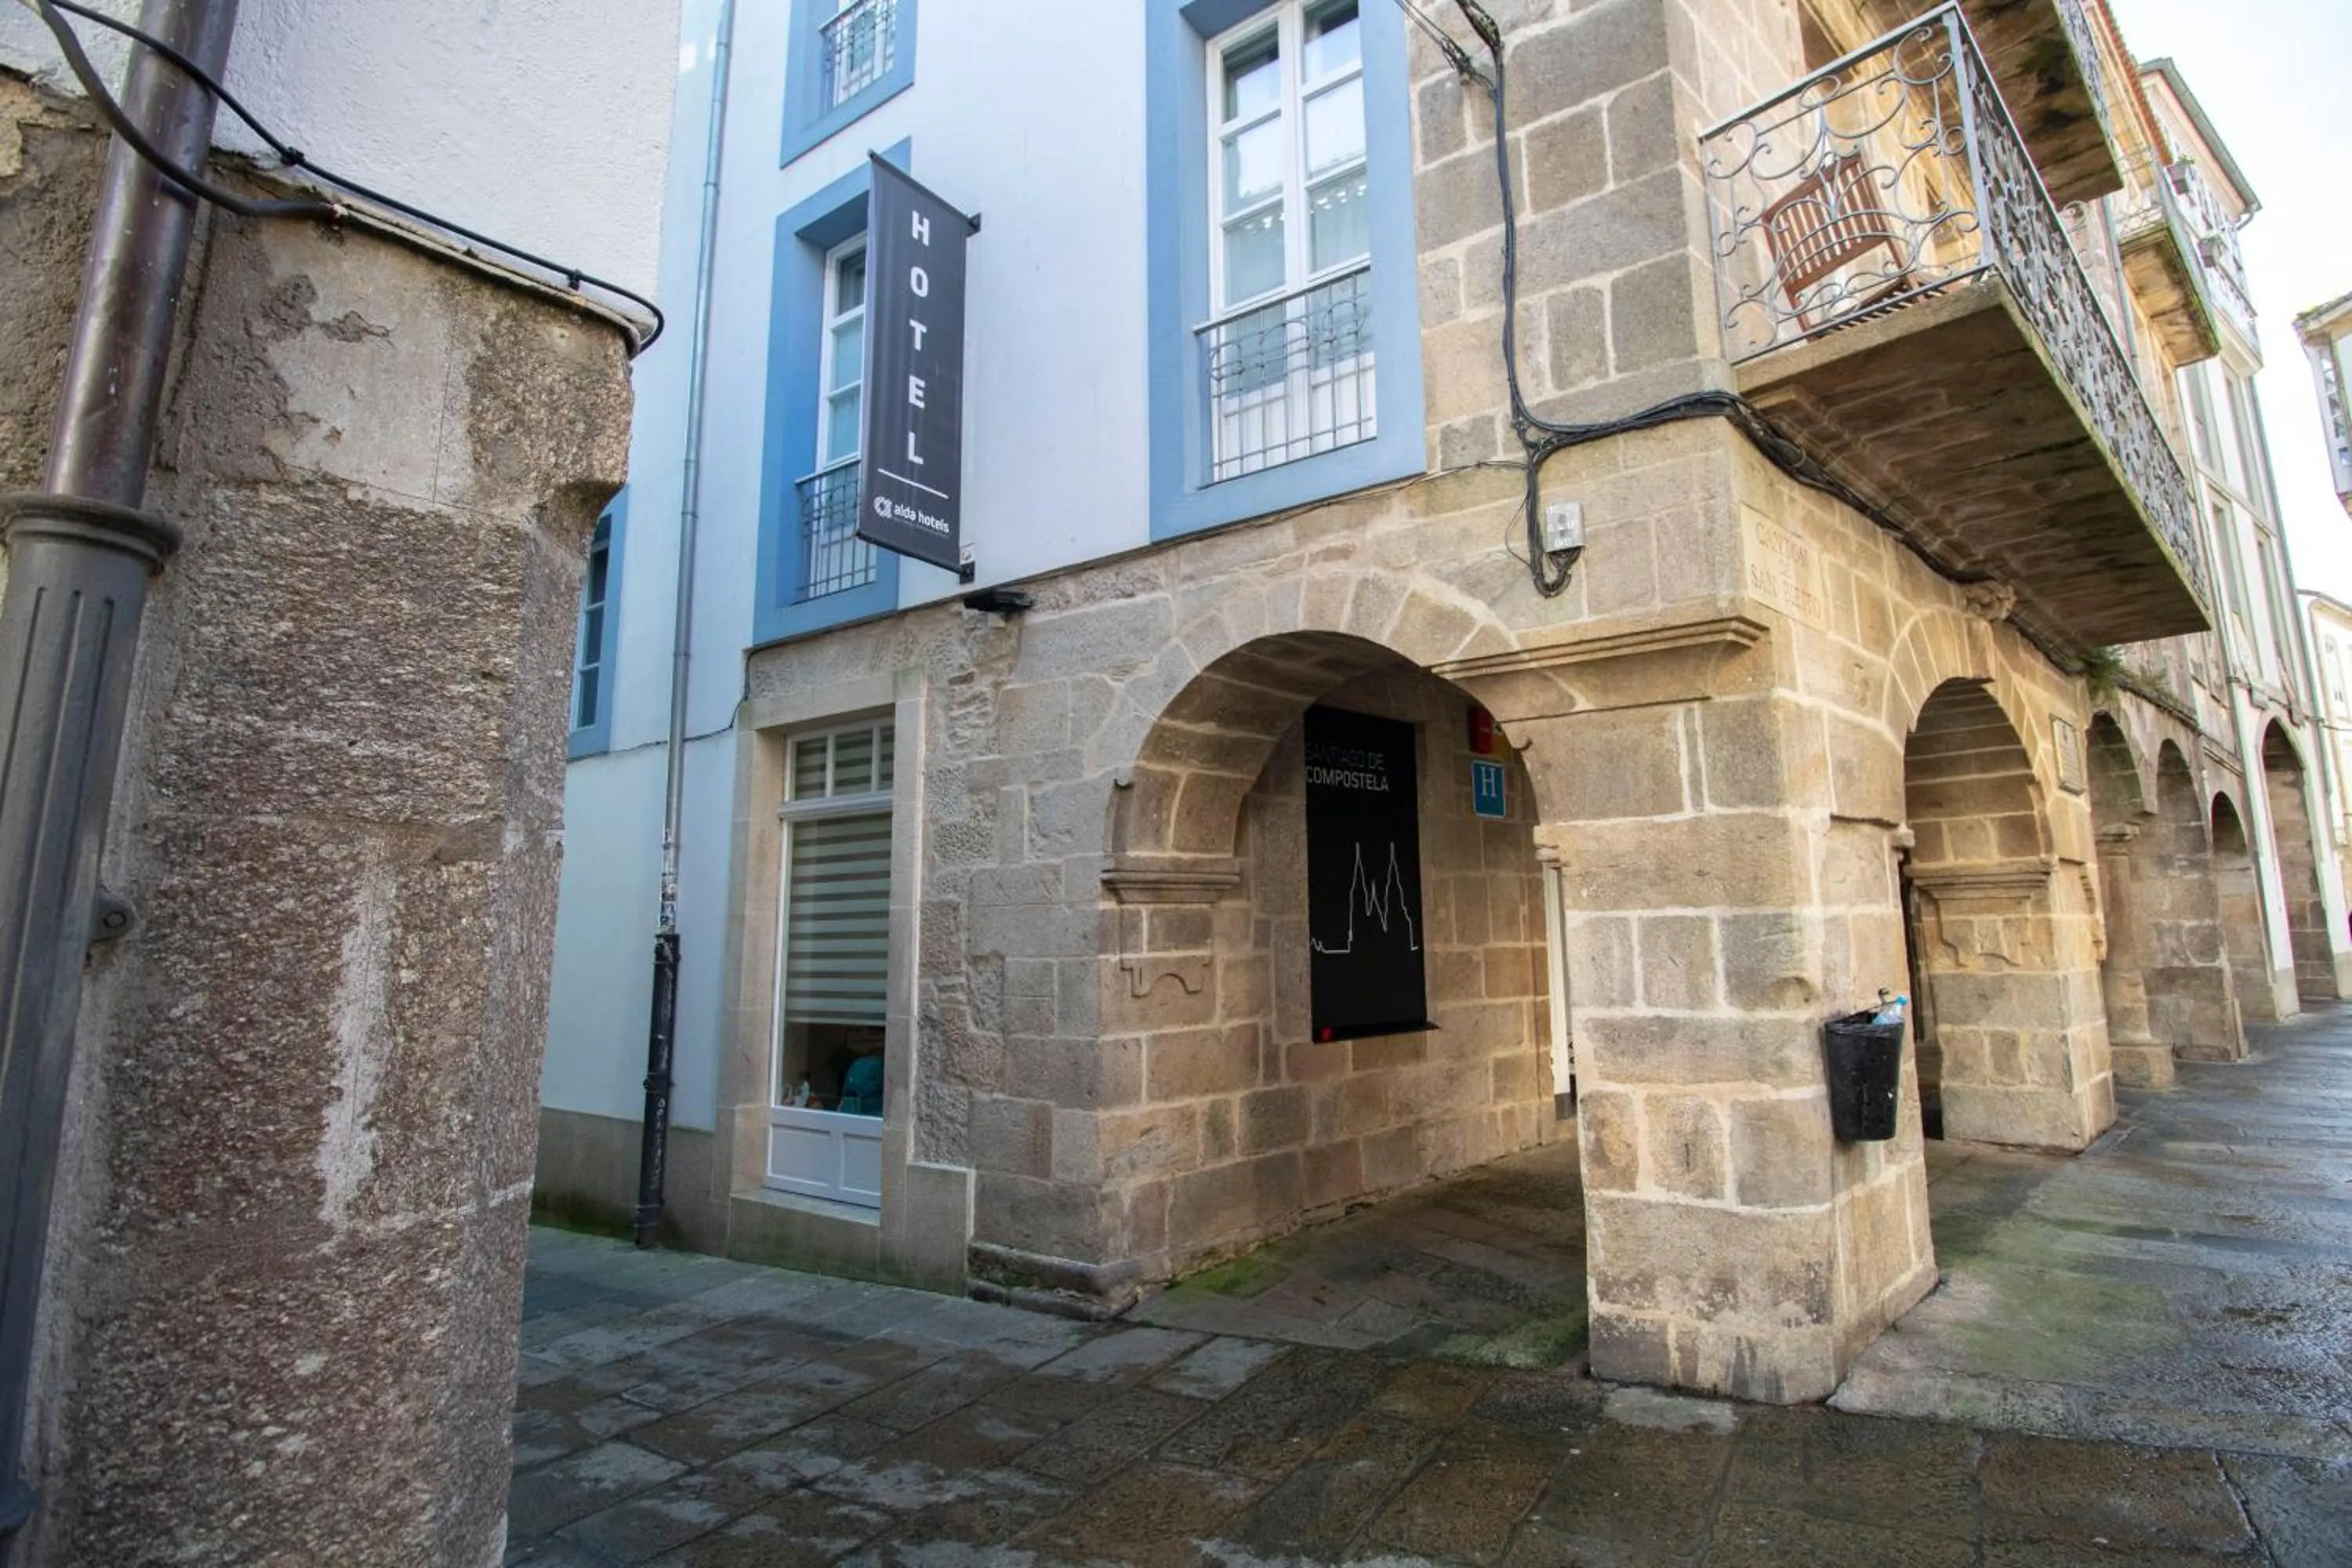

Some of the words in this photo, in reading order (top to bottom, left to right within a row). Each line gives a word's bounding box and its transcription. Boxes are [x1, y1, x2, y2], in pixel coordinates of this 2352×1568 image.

[907, 209, 931, 465] HOTEL
[894, 504, 916, 521] alda
[918, 510, 949, 533] hotels
[1368, 752, 1385, 771] DE
[1305, 765, 1389, 792] COMPOSTELA
[1480, 766, 1497, 798] H
